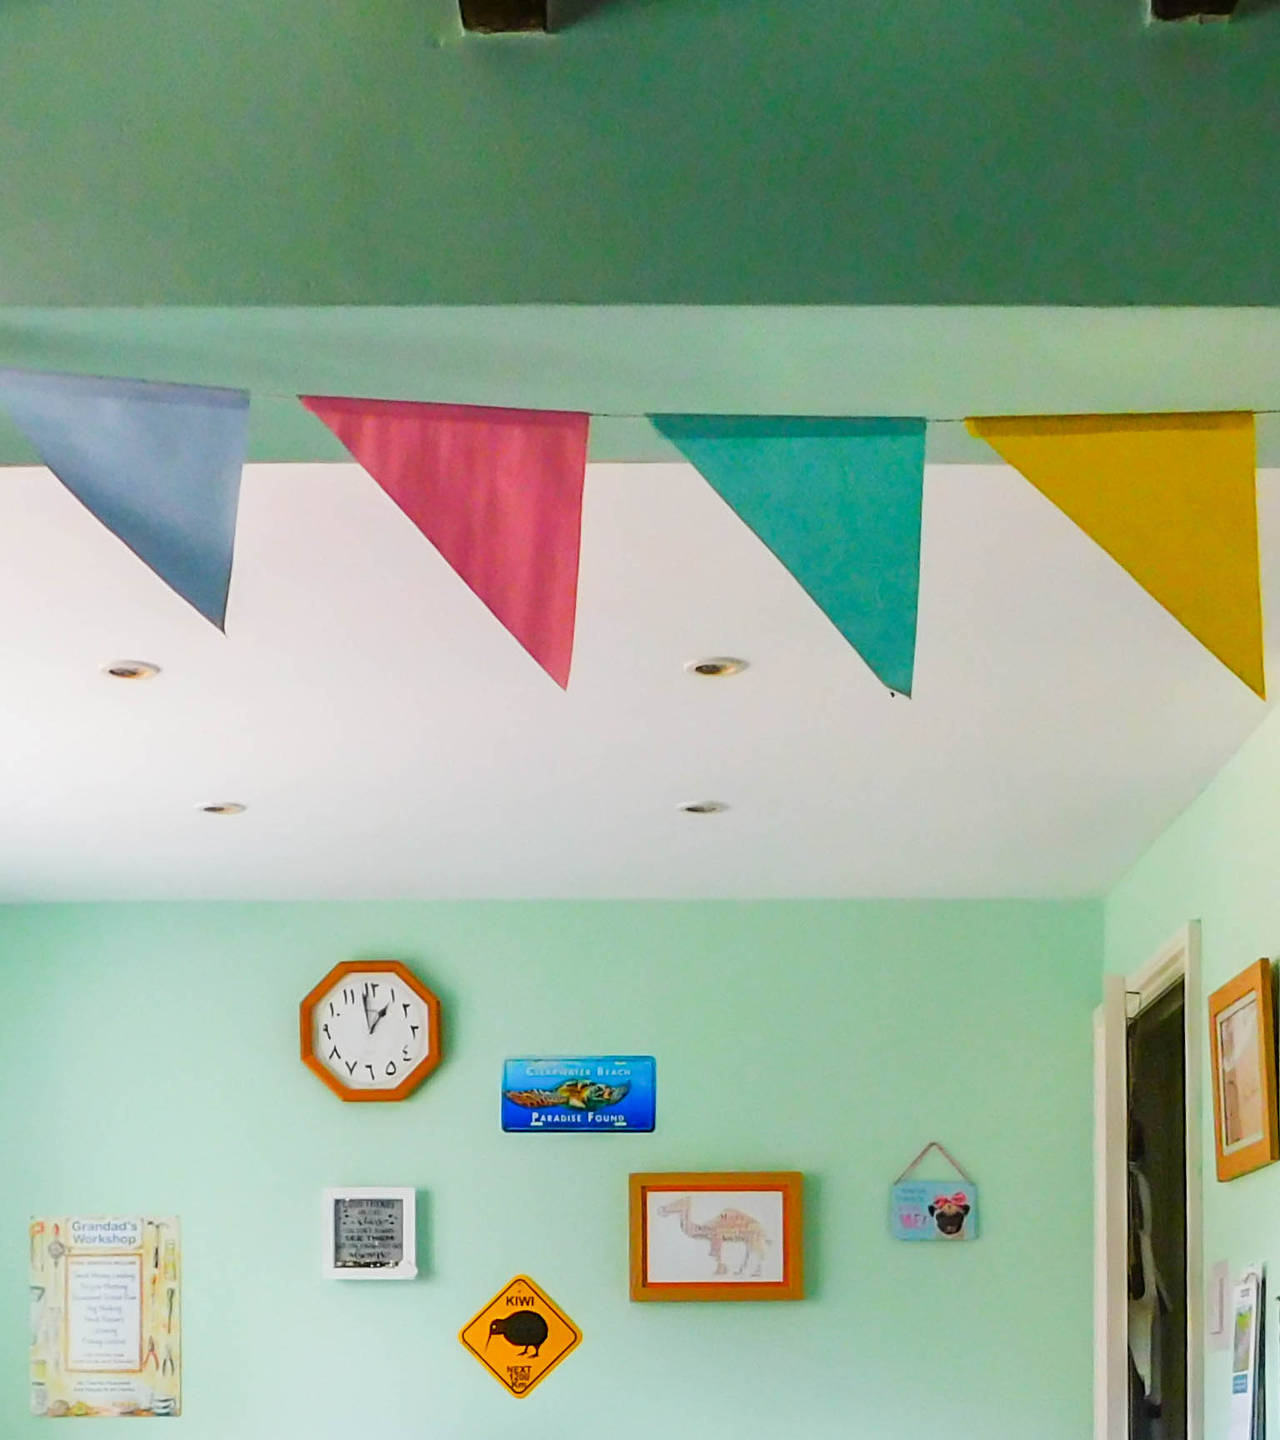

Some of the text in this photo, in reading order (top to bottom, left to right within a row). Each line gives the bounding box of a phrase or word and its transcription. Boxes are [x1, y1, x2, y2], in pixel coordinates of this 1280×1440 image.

[72, 1220, 137, 1231] Grandad's
[72, 1233, 137, 1246] Workshop
[506, 1296, 535, 1306] KIWI
